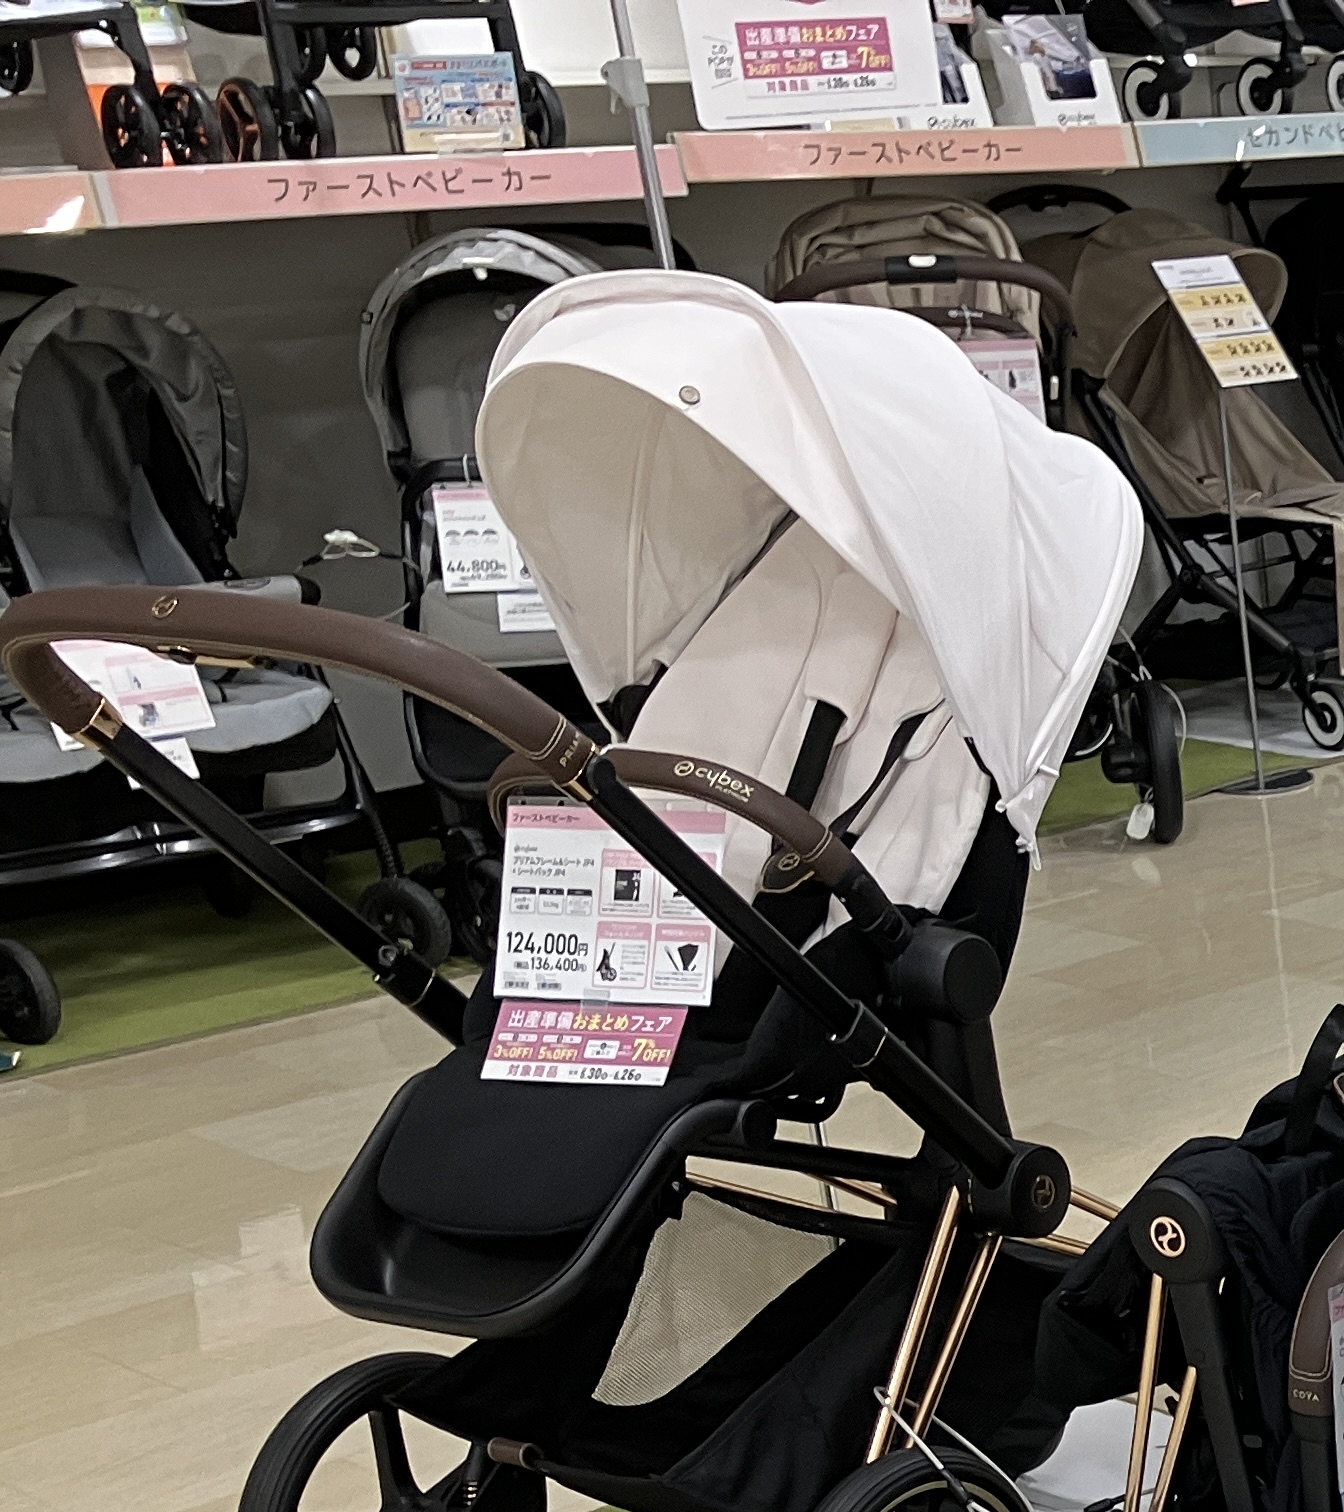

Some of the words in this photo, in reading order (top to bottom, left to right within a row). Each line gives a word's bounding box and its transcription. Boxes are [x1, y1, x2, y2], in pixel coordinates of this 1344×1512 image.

[802, 137, 1023, 167] ファーストベビーカー
[266, 167, 553, 203] ファーストベビーカー
[694, 766, 756, 798] cybex
[506, 930, 589, 957] 124,000円
[507, 1009, 674, 1034] 出産準備おまとめフェア
